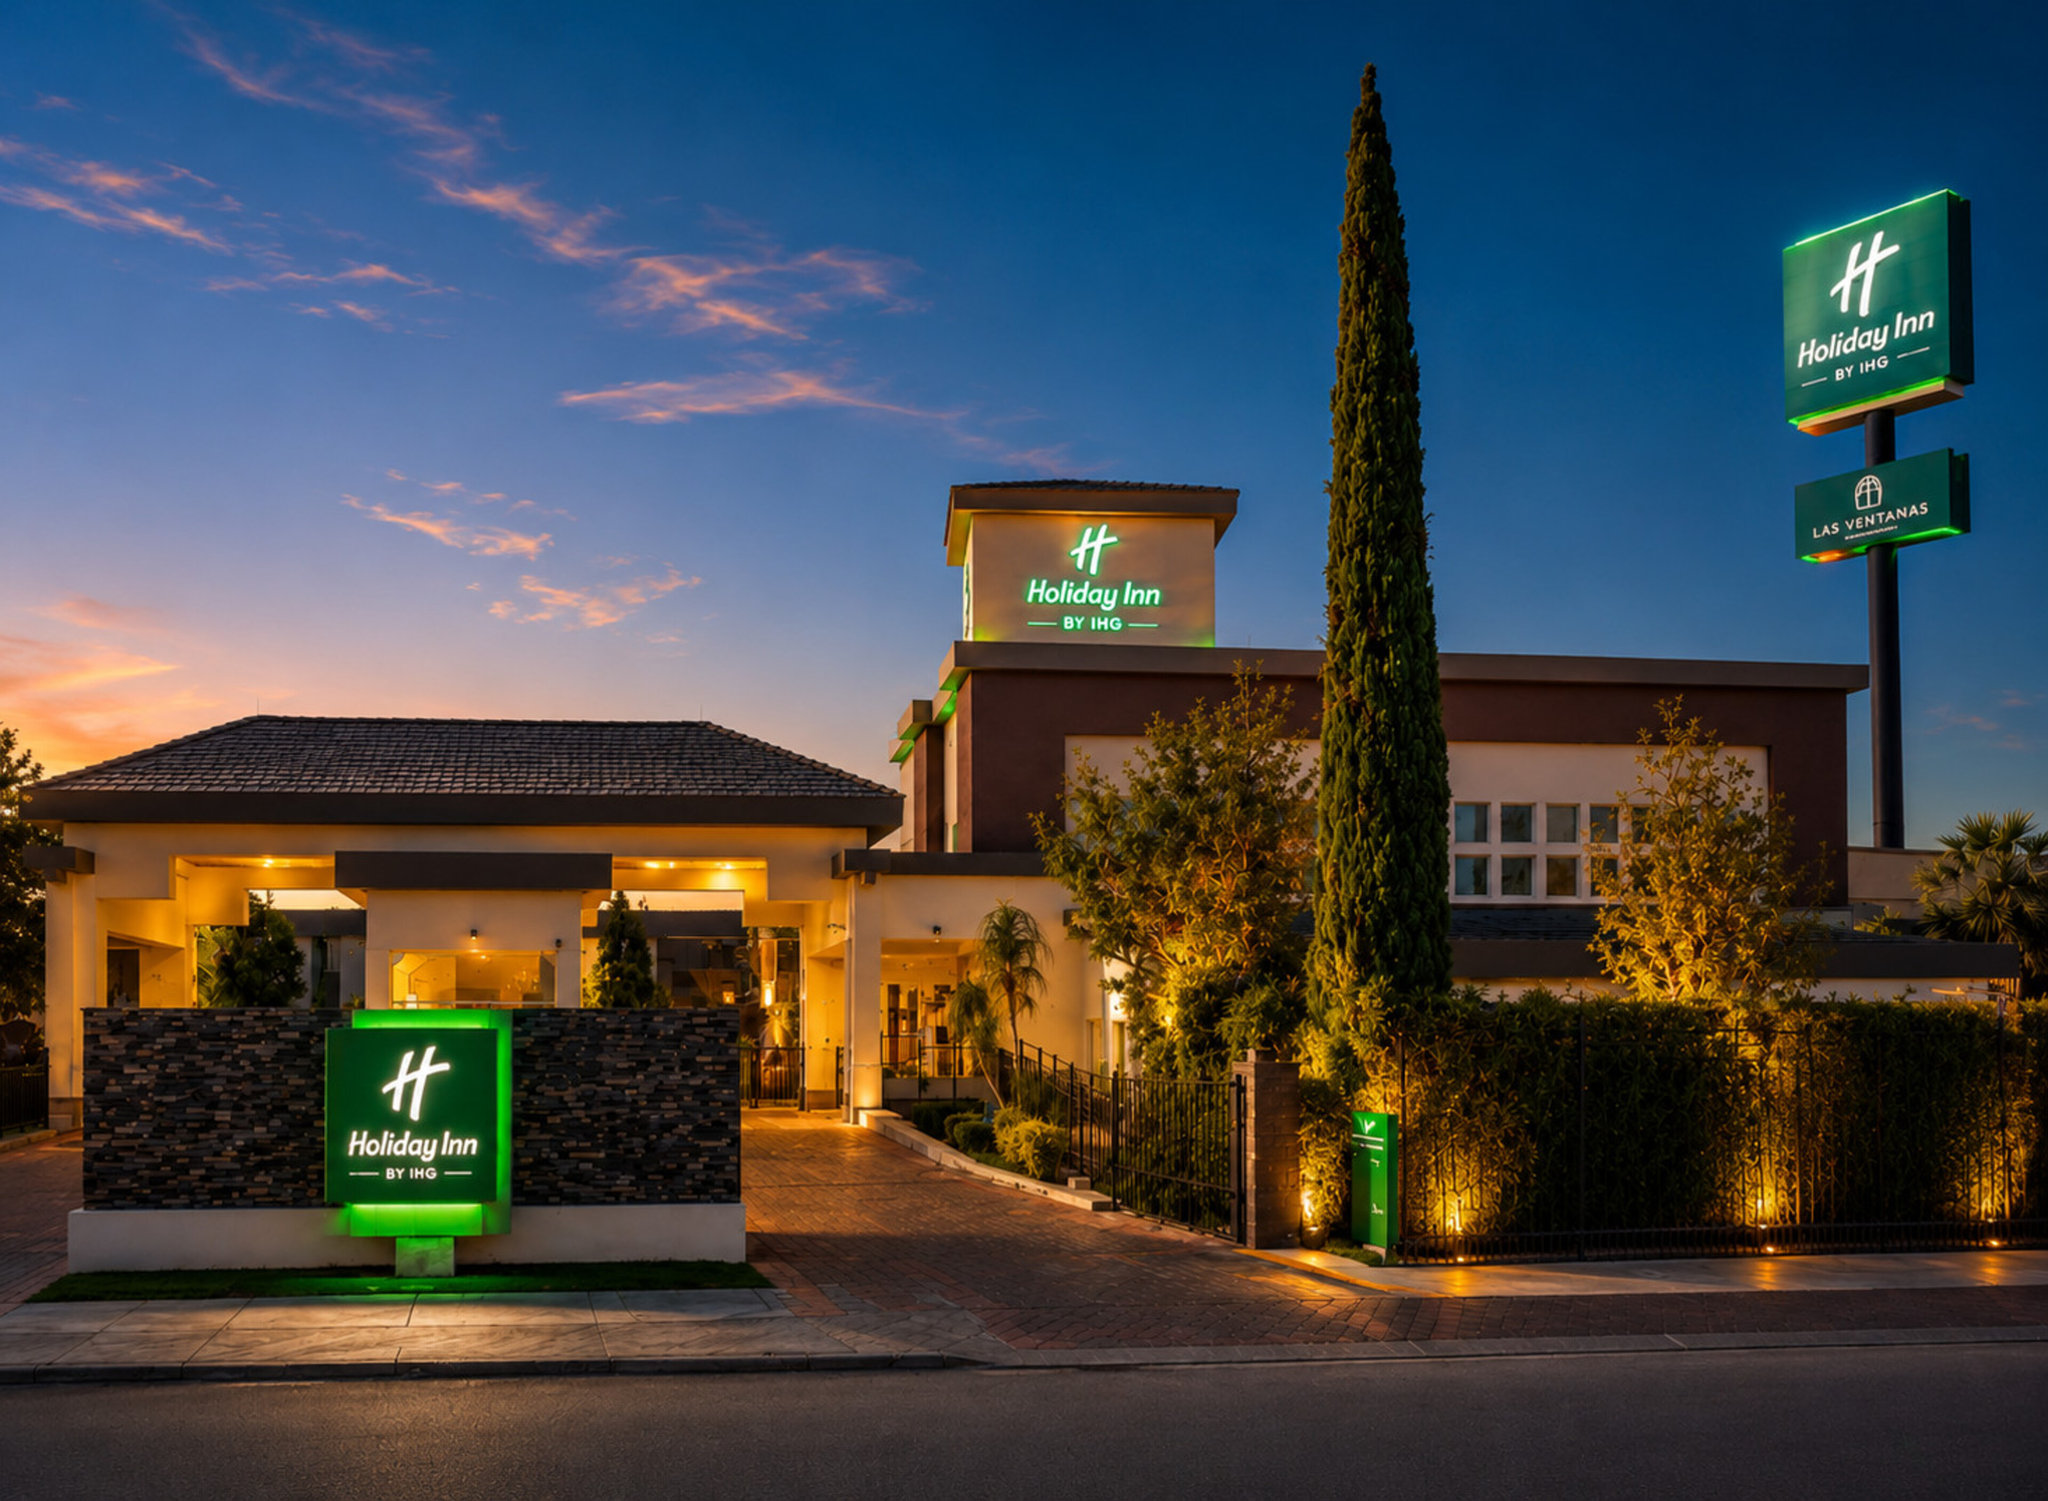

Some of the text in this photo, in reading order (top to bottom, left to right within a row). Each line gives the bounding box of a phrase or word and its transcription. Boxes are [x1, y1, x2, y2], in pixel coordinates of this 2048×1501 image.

[1797, 310, 1935, 369] Holiday Inn
[1834, 355, 1889, 381] BY IHG
[1812, 522, 1840, 539] LAS
[1844, 502, 1929, 531] VENTANAS
[1027, 578, 1161, 612] Holiday Inn
[1063, 616, 1123, 631] BY IHG
[347, 1130, 478, 1163] Holiday Inn
[385, 1167, 438, 1180] BY IHG
